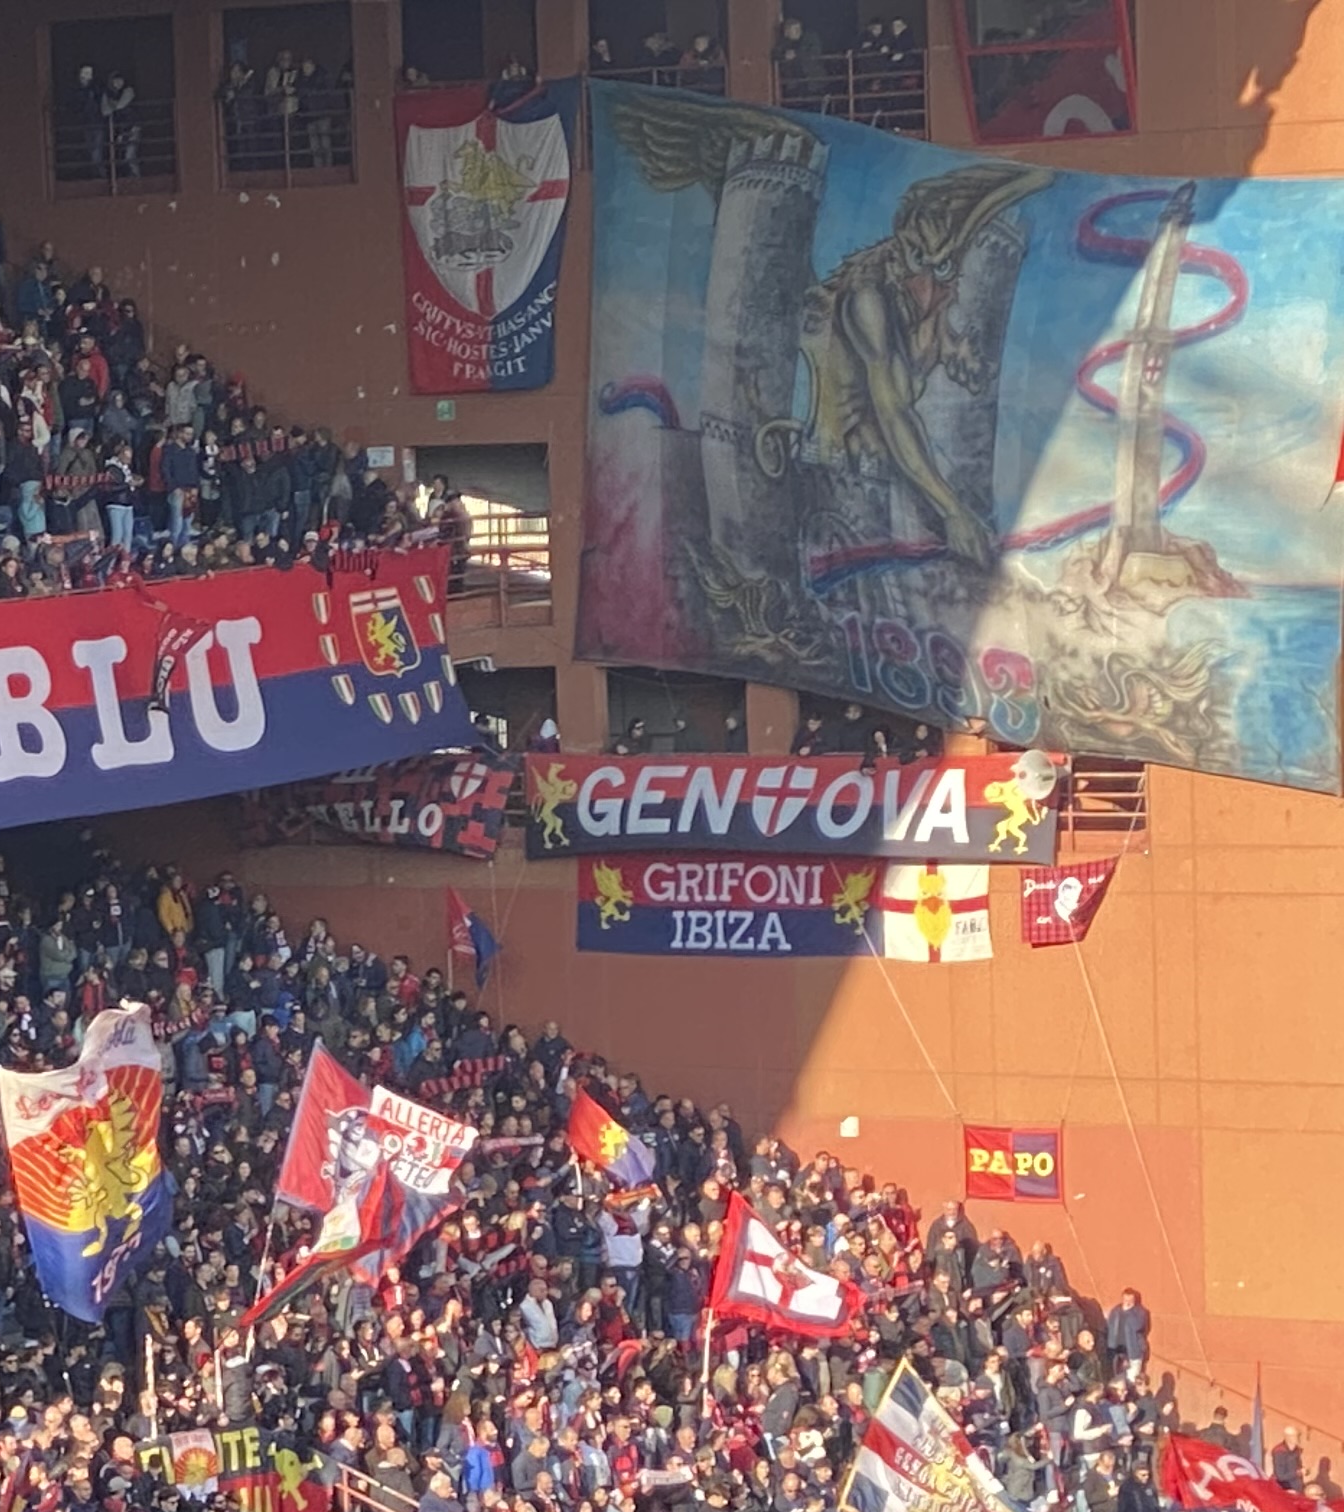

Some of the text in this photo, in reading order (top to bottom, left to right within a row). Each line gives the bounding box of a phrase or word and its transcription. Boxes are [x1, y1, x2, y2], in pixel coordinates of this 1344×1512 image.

[575, 765, 970, 843] GENOVA
[642, 862, 826, 906] GRIFONI
[669, 908, 793, 953] IBIZA
[378, 1096, 467, 1147] ALLERTA
[969, 1146, 1056, 1180] PAPO
